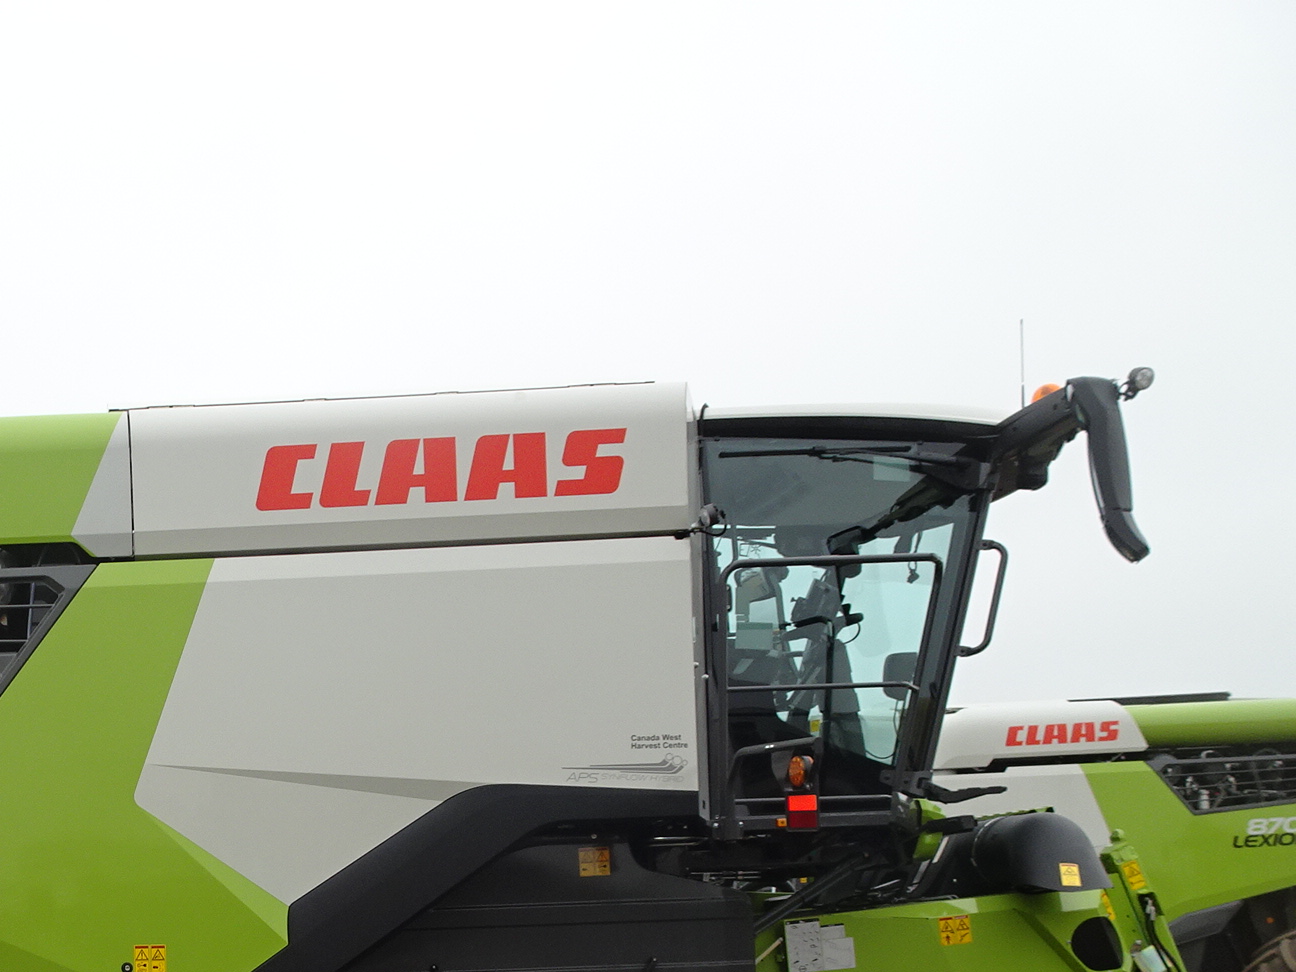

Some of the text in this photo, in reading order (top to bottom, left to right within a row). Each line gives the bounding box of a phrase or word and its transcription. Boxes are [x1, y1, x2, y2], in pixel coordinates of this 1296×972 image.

[255, 427, 627, 511] CLAAS
[1005, 720, 1120, 747] CLAAS
[566, 772, 600, 784] APS
